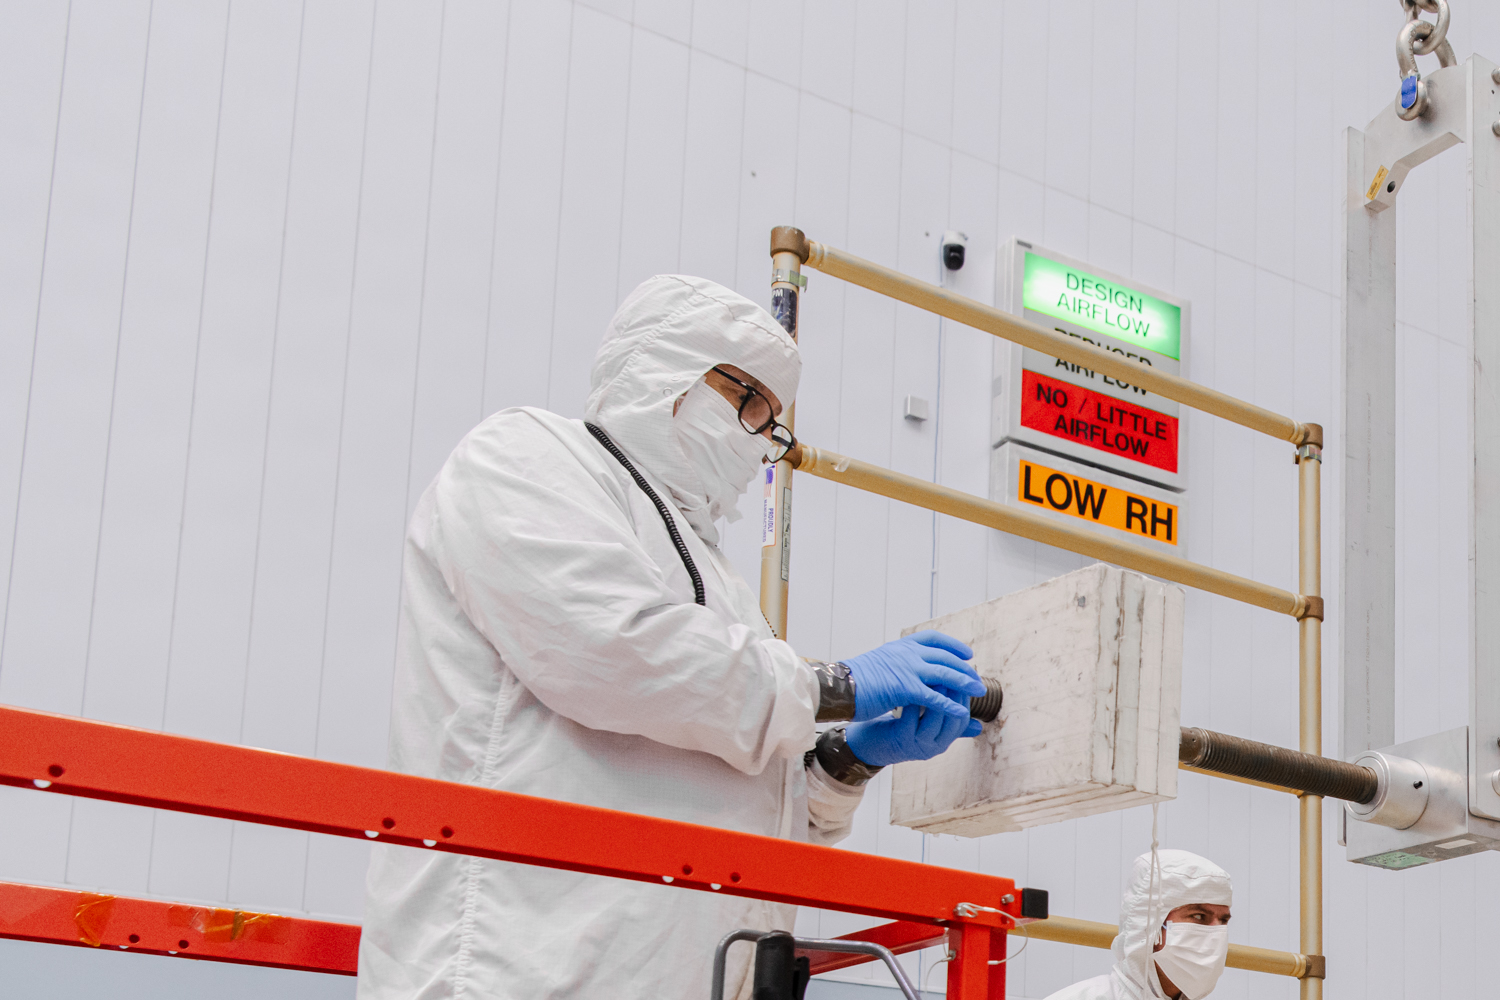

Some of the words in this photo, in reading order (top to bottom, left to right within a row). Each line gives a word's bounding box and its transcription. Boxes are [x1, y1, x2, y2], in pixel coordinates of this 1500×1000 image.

[1056, 292, 1150, 338] AIRFLOW
[1066, 272, 1142, 314] DESIGN
[1036, 383, 1068, 409] NO
[1078, 396, 1088, 414] /
[1096, 402, 1167, 441] LITTLE
[1054, 416, 1150, 457] AIRFLOW
[1023, 465, 1107, 520] LOW
[1125, 495, 1174, 541] RH
